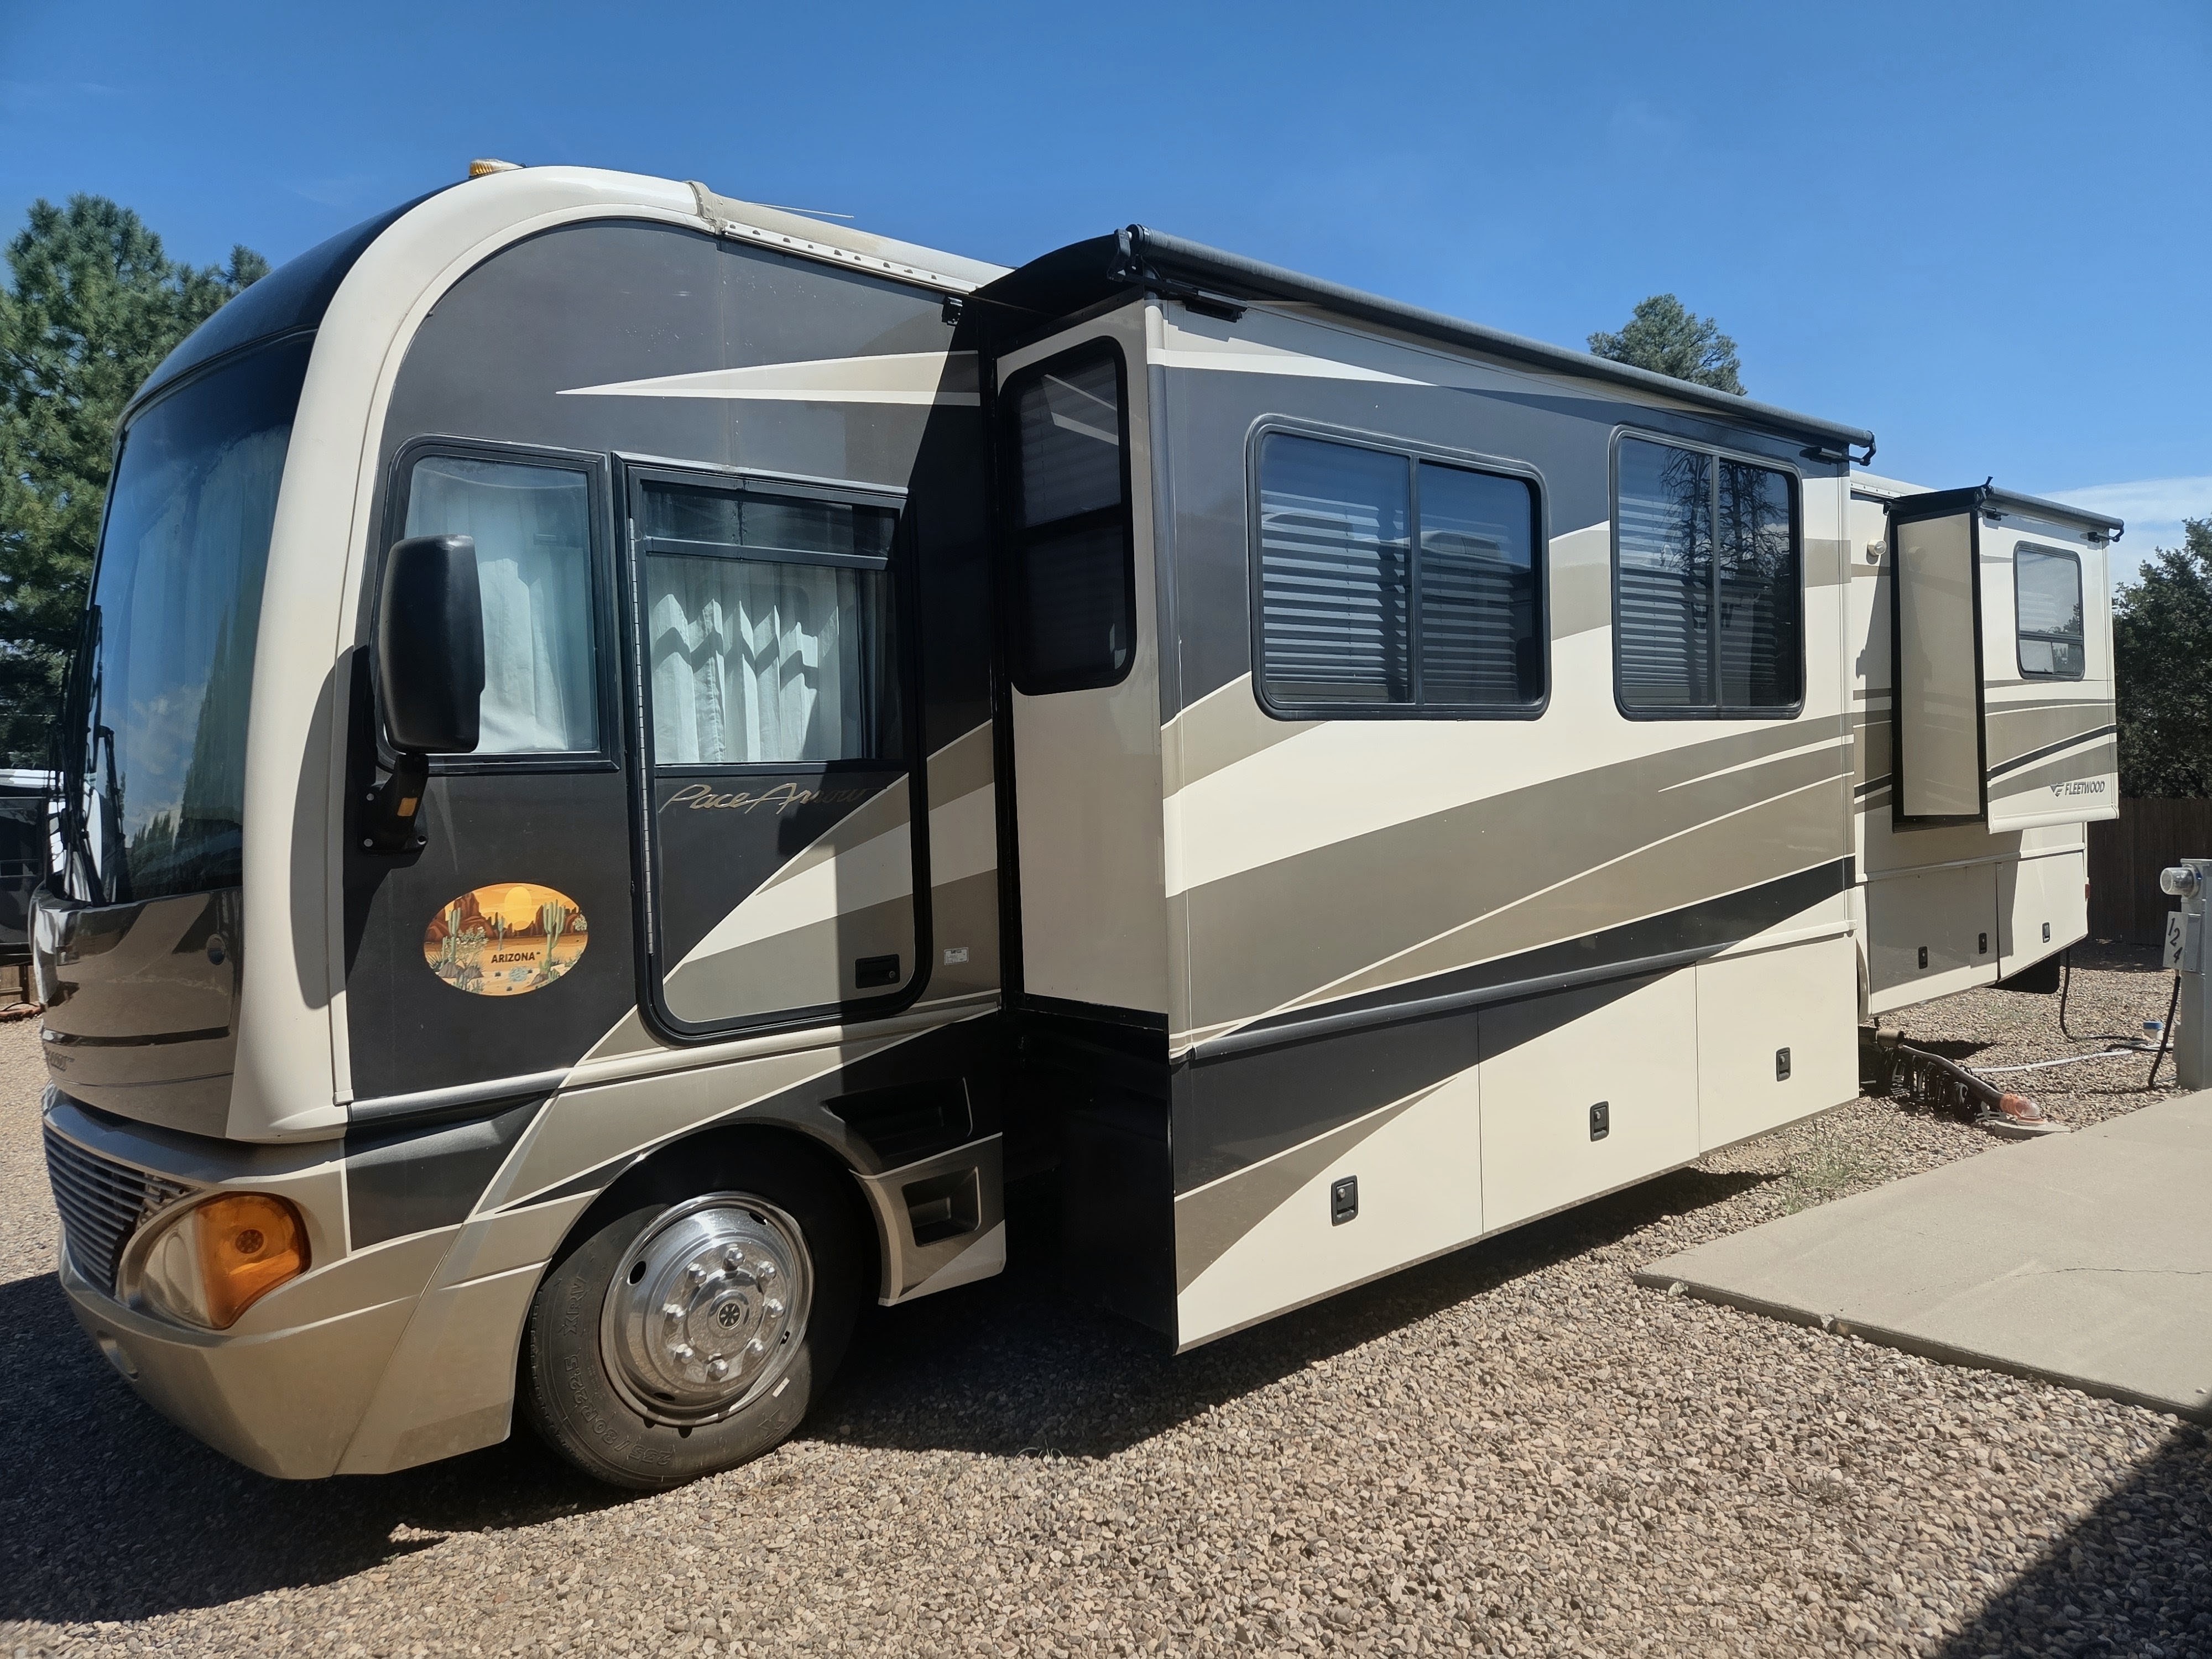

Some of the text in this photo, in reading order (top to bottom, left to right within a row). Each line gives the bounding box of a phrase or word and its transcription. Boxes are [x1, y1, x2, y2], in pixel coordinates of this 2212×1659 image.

[658, 784, 751, 813] Pace
[2064, 780, 2105, 795] FLEETWOOD
[2168, 917, 2183, 963] 124
[492, 952, 535, 964] ARIZONA
